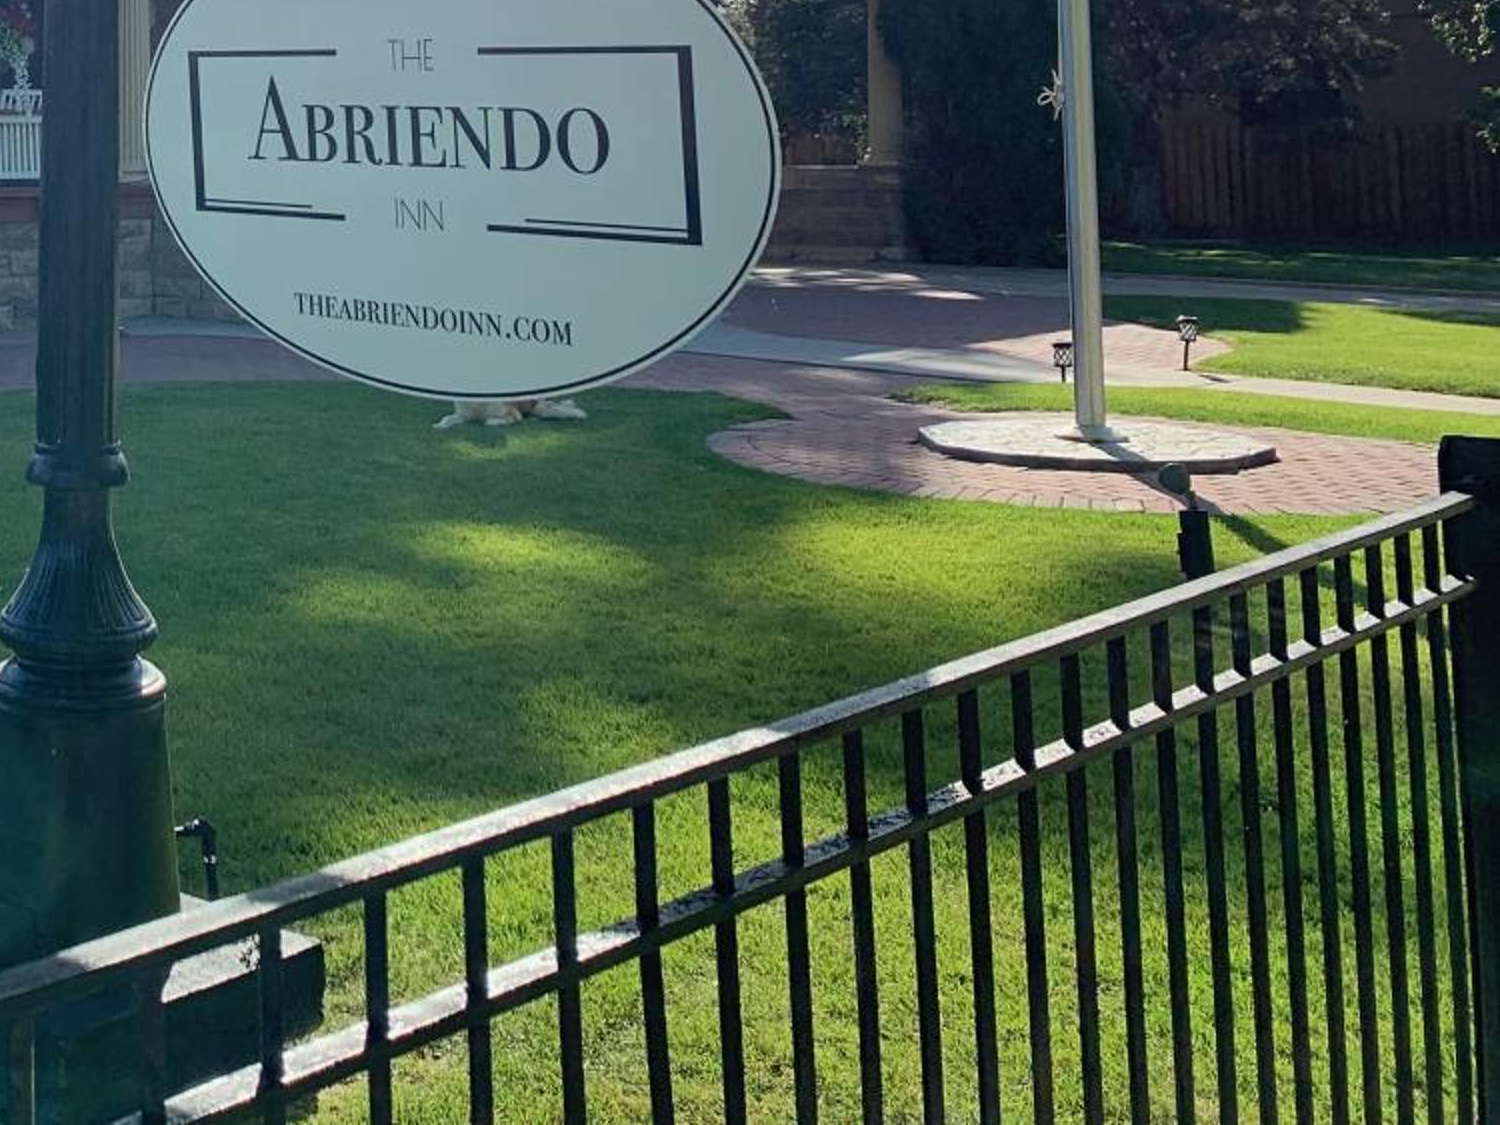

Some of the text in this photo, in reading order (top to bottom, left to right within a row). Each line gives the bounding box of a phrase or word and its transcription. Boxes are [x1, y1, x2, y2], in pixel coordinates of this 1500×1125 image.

[387, 38, 435, 72] THE
[247, 74, 611, 176] ABRIENDO
[393, 198, 445, 231] INN
[293, 291, 574, 346] THEABRIENDOINN.COM
